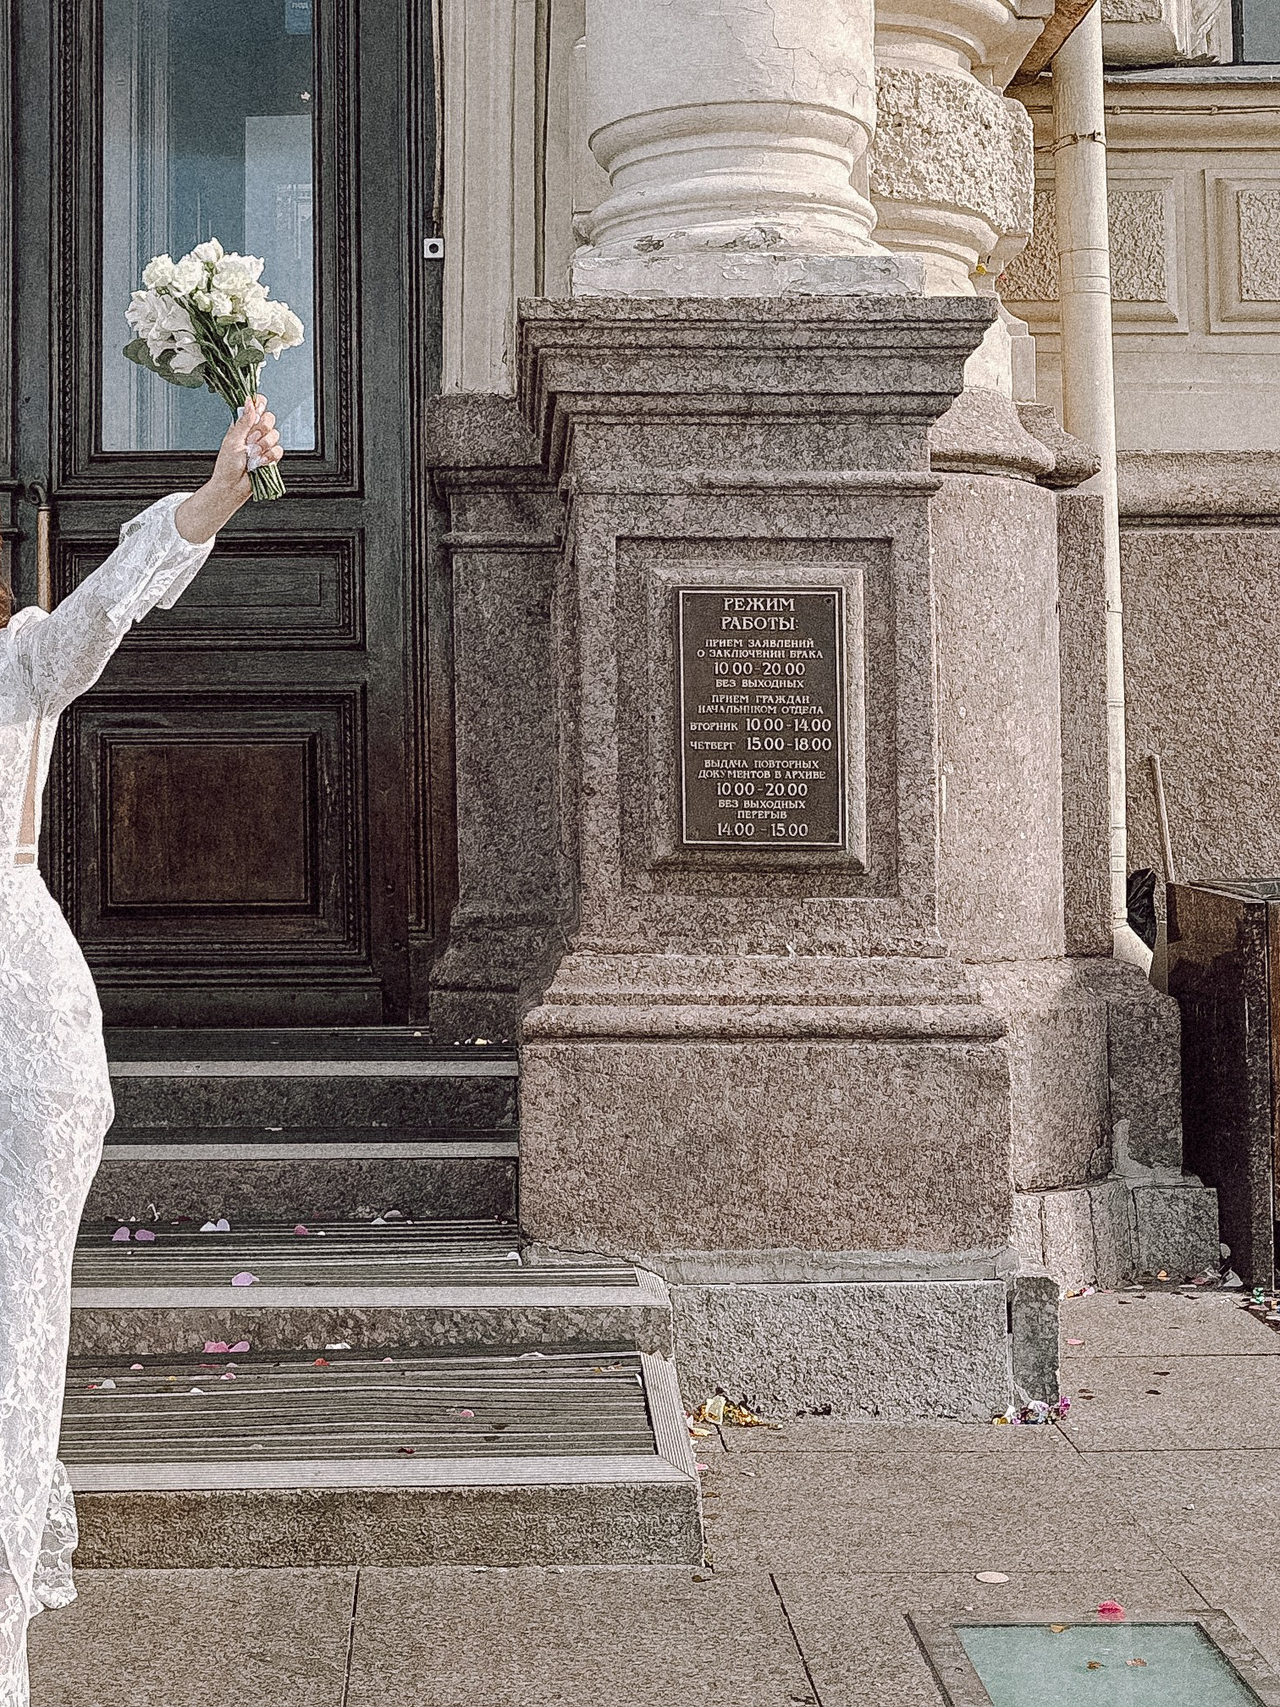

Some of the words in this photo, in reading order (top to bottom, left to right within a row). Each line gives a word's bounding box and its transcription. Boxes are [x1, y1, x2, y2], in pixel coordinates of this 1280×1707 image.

[723, 597, 796, 612] РЕЖИМ
[720, 616, 799, 631] РАБОТЫ:
[705, 639, 744, 648] ПРИЕМ
[747, 637, 815, 648] ЗАЯВЛЕНИЙ
[696, 649, 706, 658] О
[709, 649, 786, 659] ЗАКЛЮЧЕНИИ
[789, 649, 824, 659] БРАКА
[715, 679, 737, 688] БЕЗ
[741, 679, 805, 689] ВЫХОДНЫХ
[711, 694, 749, 704] ПРИЕМ
[755, 694, 810, 705] ГРАЖДАН
[697, 704, 777, 714] НАЧАЛЬНИКОМ
[781, 705, 824, 715] ОТДЕЛА
[689, 721, 739, 731] ВТОРНИК
[689, 740, 737, 751] ЧЕТВЕРГ
[704, 759, 749, 769] ВЫДАЧА
[754, 760, 820, 769] ПОВТОРНЫХ
[697, 770, 771, 780] ДОКУМЕНТОВ
[774, 770, 782, 779] В
[784, 770, 827, 780] АРХИВЕ
[718, 799, 739, 809] БЕЗ
[743, 799, 807, 810] ВЫХОДНЫХ
[737, 810, 788, 820] ПЕРЕРЫВ
